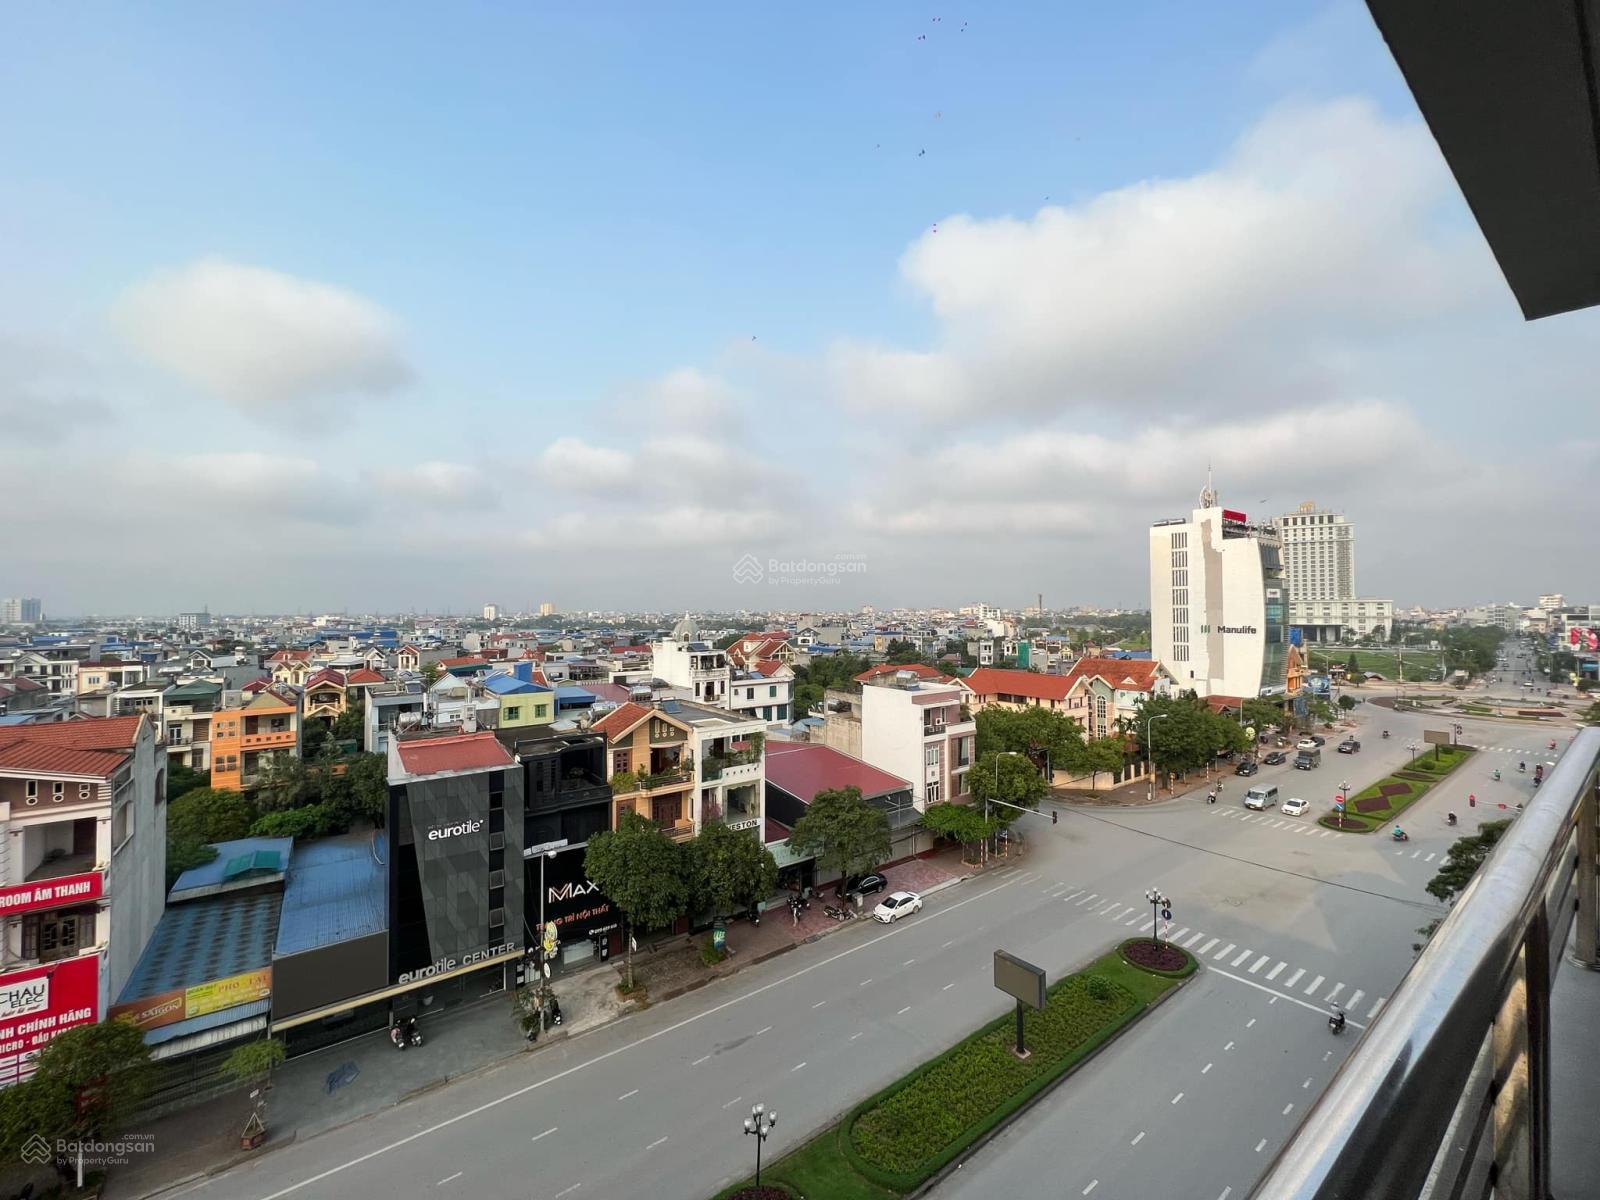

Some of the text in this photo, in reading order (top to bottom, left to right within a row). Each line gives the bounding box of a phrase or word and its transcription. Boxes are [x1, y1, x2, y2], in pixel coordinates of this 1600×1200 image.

[1217, 625, 1257, 634] Manulife
[428, 820, 483, 840] eurotile
[55, 881, 91, 897] THANH
[399, 942, 515, 985] eurotile CENTER
[11, 994, 45, 1009] ELEC
[18, 1015, 56, 1035] CHÍNH
[60, 1007, 91, 1024] HÃNG
